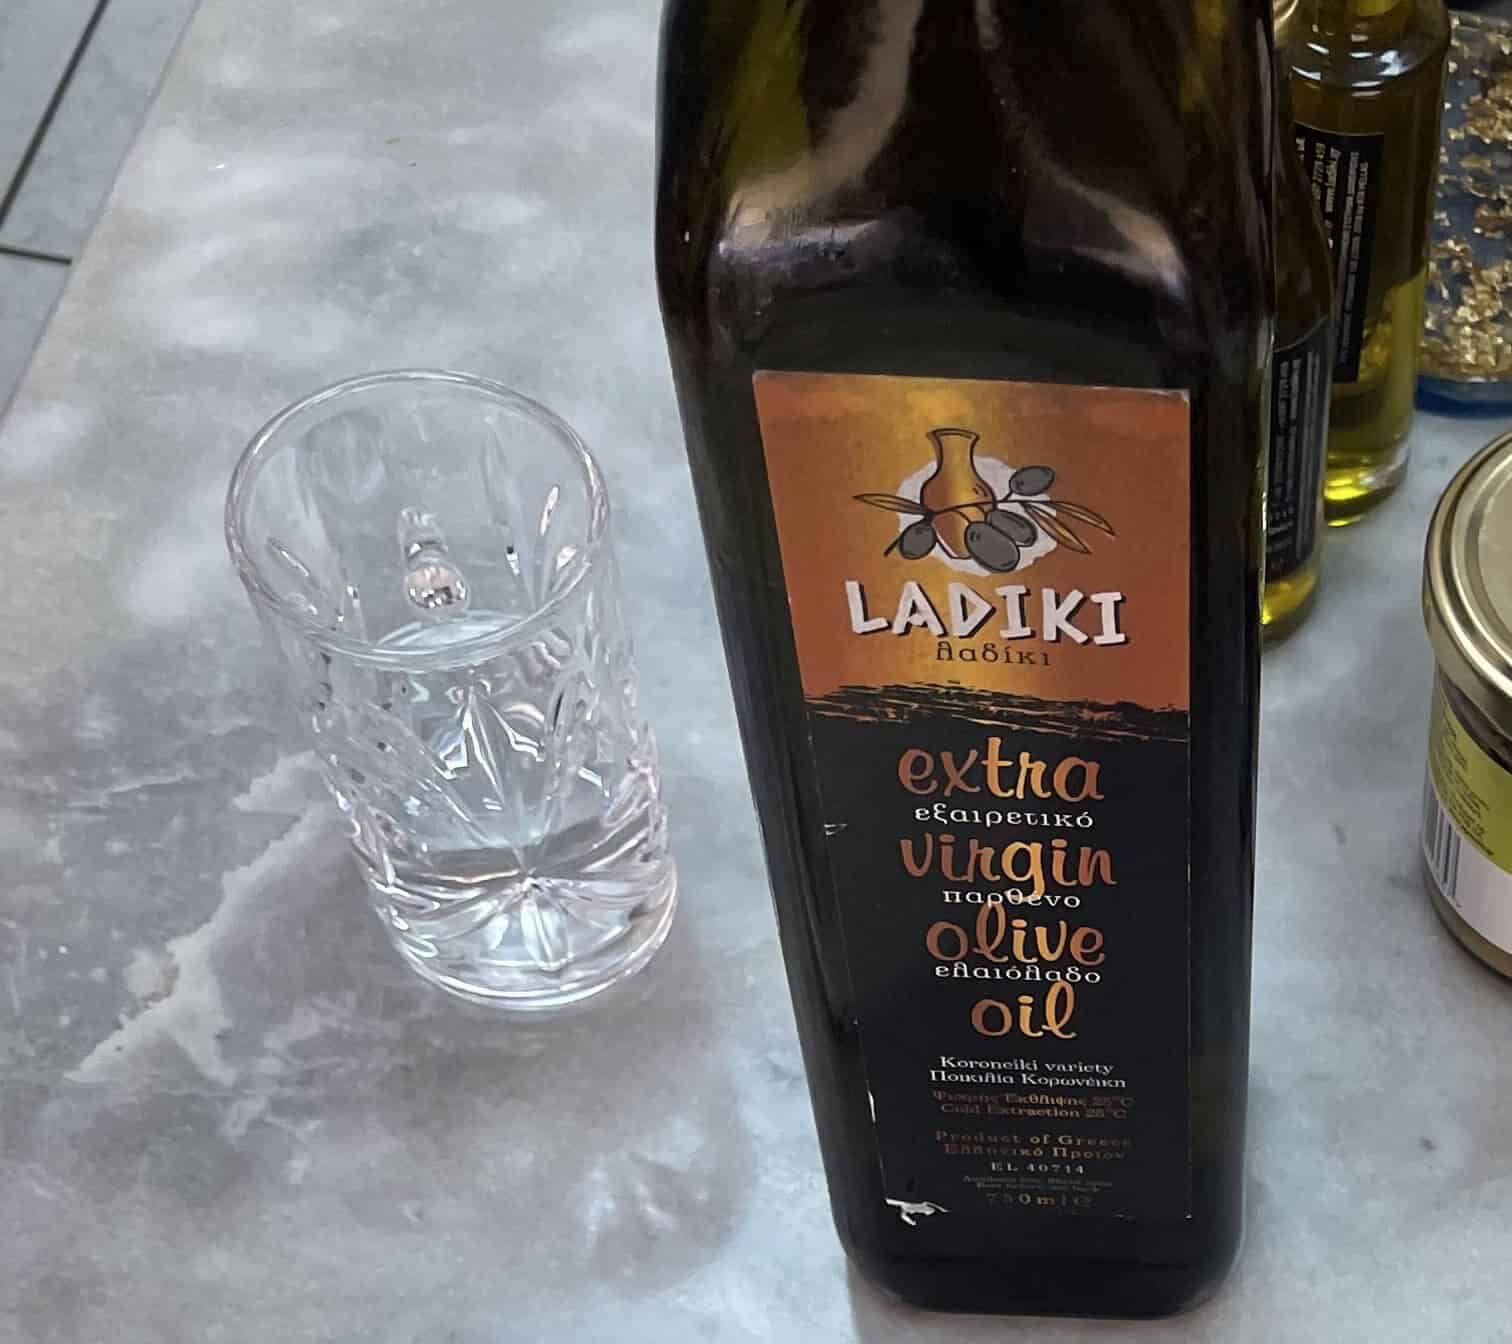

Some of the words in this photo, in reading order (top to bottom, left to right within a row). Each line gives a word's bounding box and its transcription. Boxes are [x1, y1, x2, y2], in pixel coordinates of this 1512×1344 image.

[844, 579, 1128, 645] LADIKI
[935, 640, 1052, 667] λαδίκι
[898, 736, 1105, 802] extra
[914, 802, 1094, 829] εξαιρετικό
[900, 833, 1118, 903] virgin
[926, 901, 1106, 966] olive
[971, 980, 1077, 1039] oil
[940, 1056, 1038, 1072] Koroneiki
[1044, 1061, 1114, 1076] variety
[1030, 1134, 1050, 1145] of
